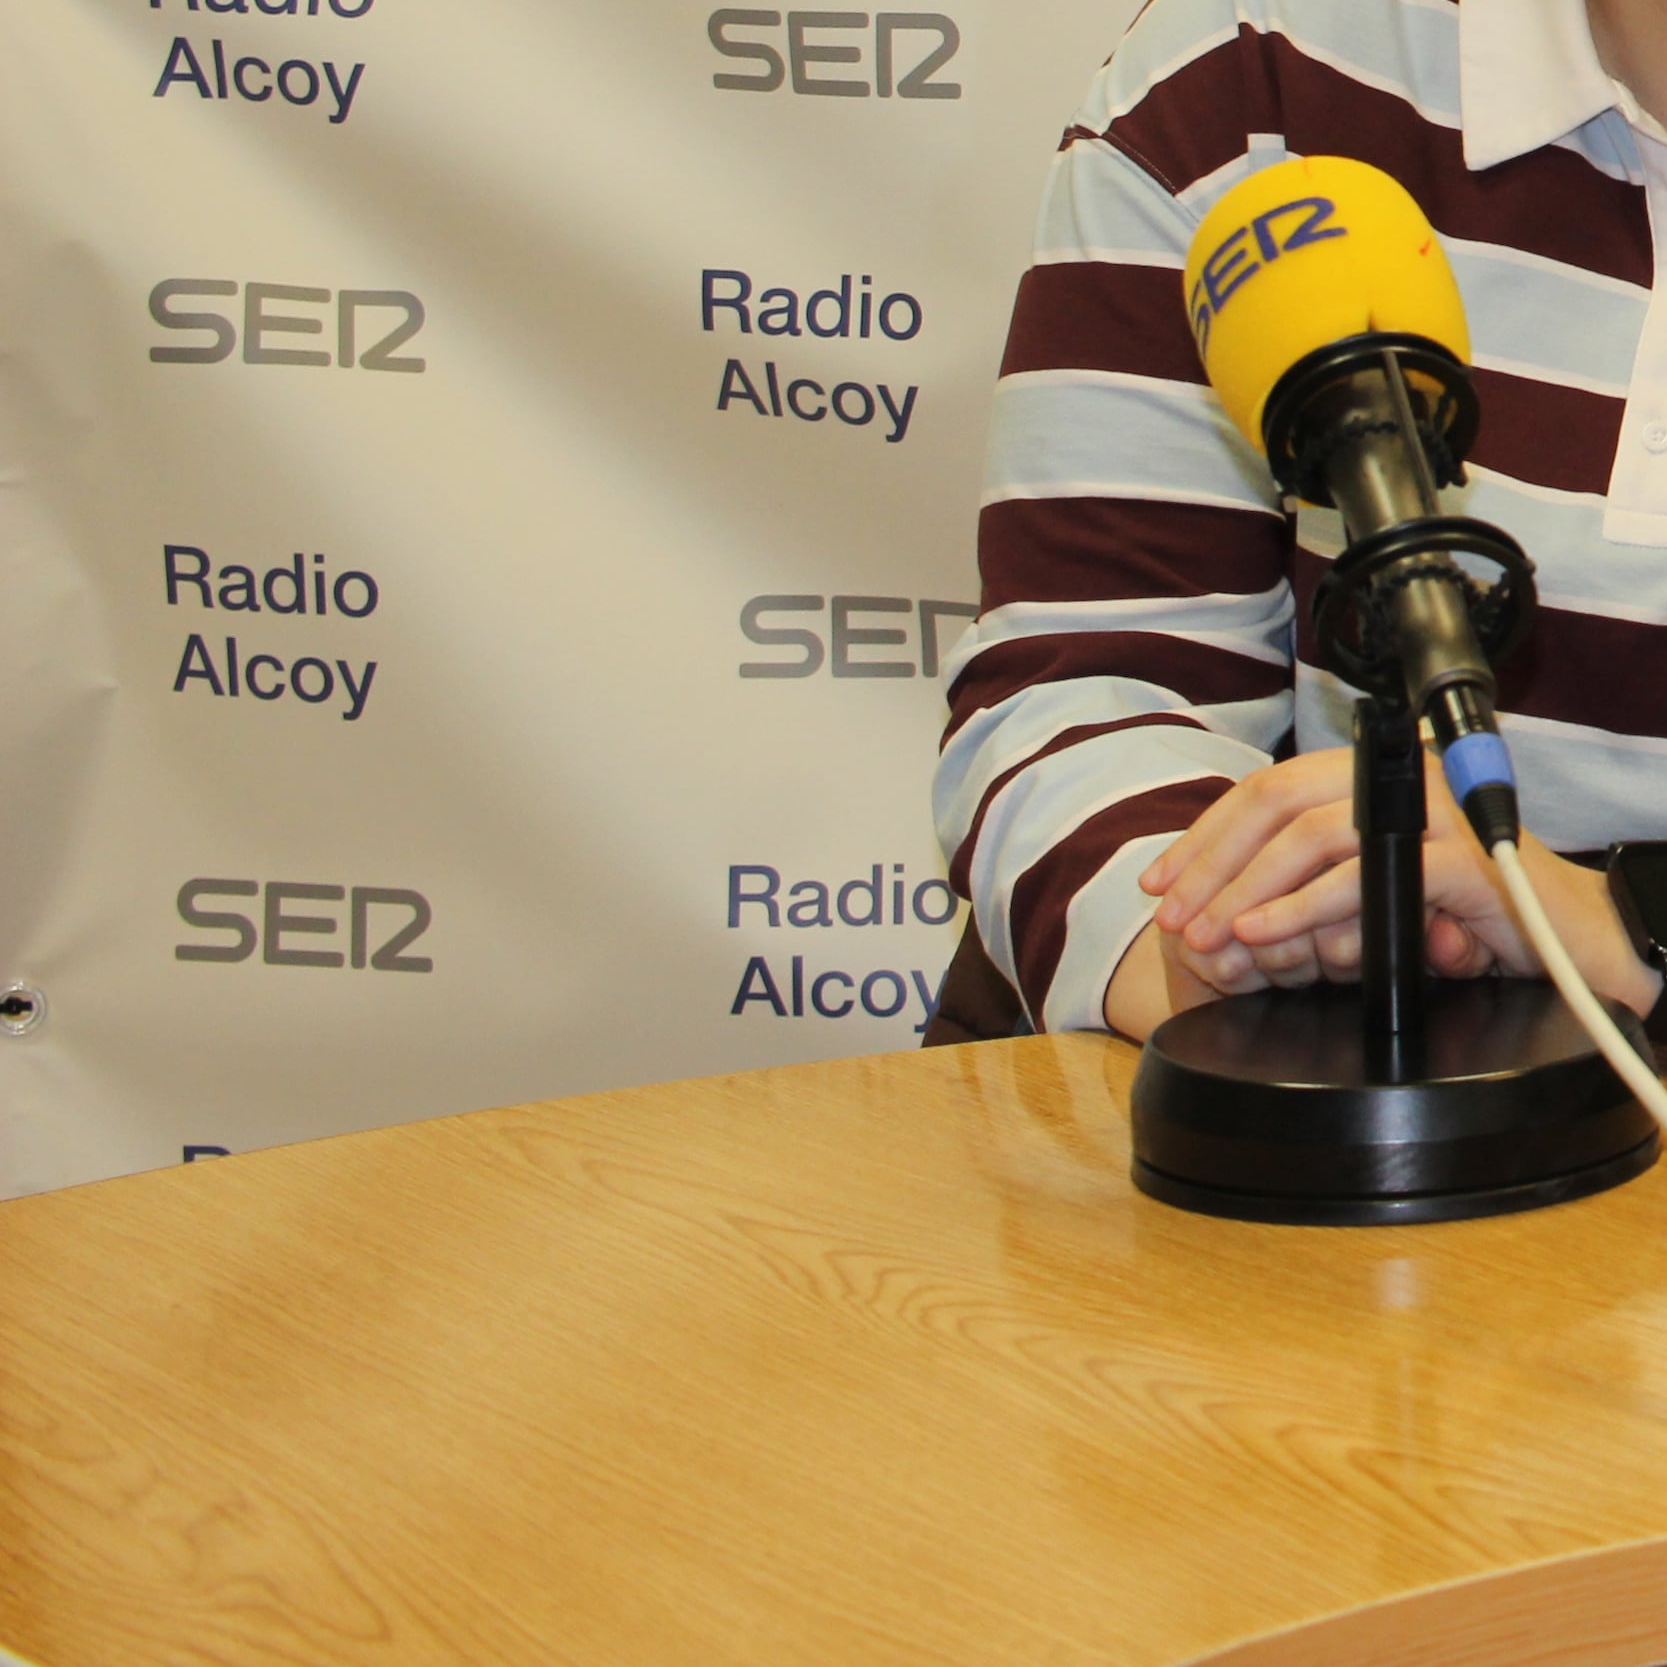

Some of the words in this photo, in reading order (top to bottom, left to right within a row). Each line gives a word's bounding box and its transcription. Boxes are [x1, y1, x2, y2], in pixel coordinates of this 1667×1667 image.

[153, 36, 365, 125] Alcoy
[707, 8, 961, 99] SER
[148, 279, 425, 373] SER
[701, 269, 922, 341] Radio
[716, 358, 919, 443] Alcoy
[163, 544, 379, 618] Radio
[173, 633, 377, 721] Alcoy
[175, 878, 433, 973] SER
[728, 863, 959, 928] Radio
[730, 955, 948, 1033] Alcoy
